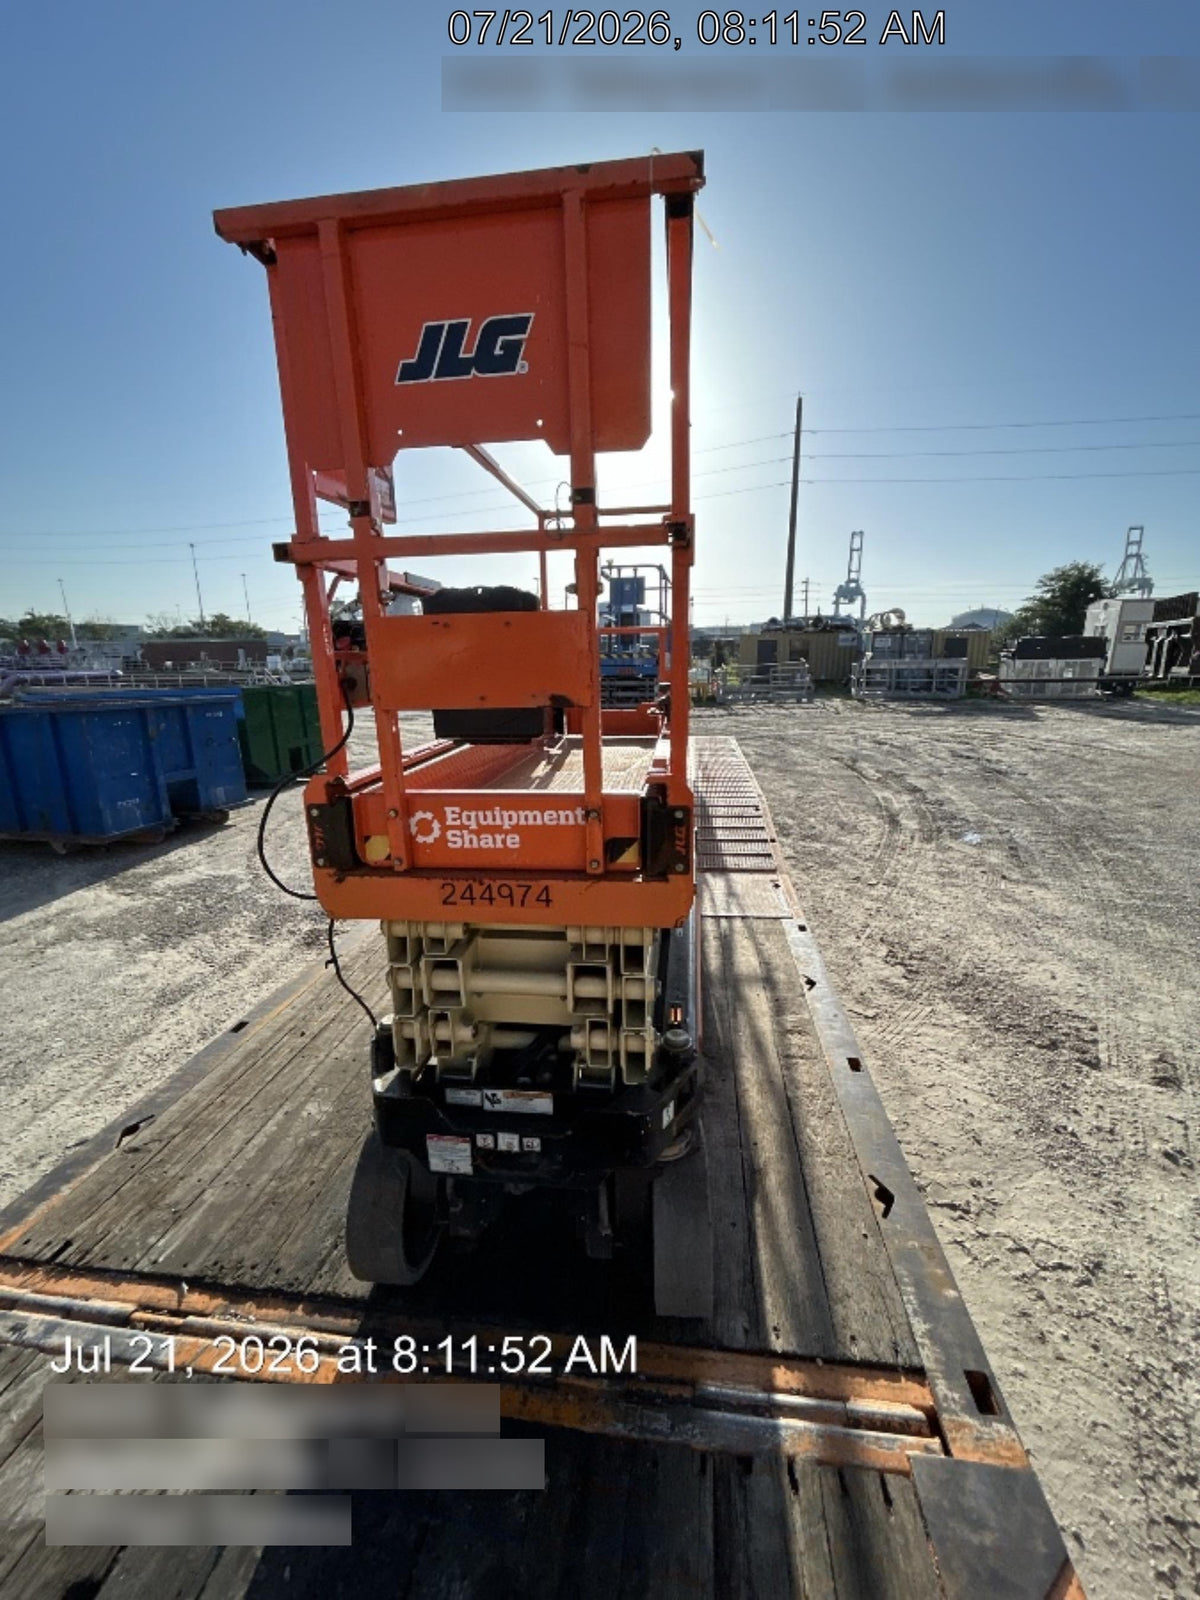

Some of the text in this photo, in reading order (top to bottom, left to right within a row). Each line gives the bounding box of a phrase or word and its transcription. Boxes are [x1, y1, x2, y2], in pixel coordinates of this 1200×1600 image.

[394, 312, 535, 386] JLG
[444, 807, 585, 829] Equipment
[446, 829, 520, 848] Share
[440, 882, 553, 908] 244974
